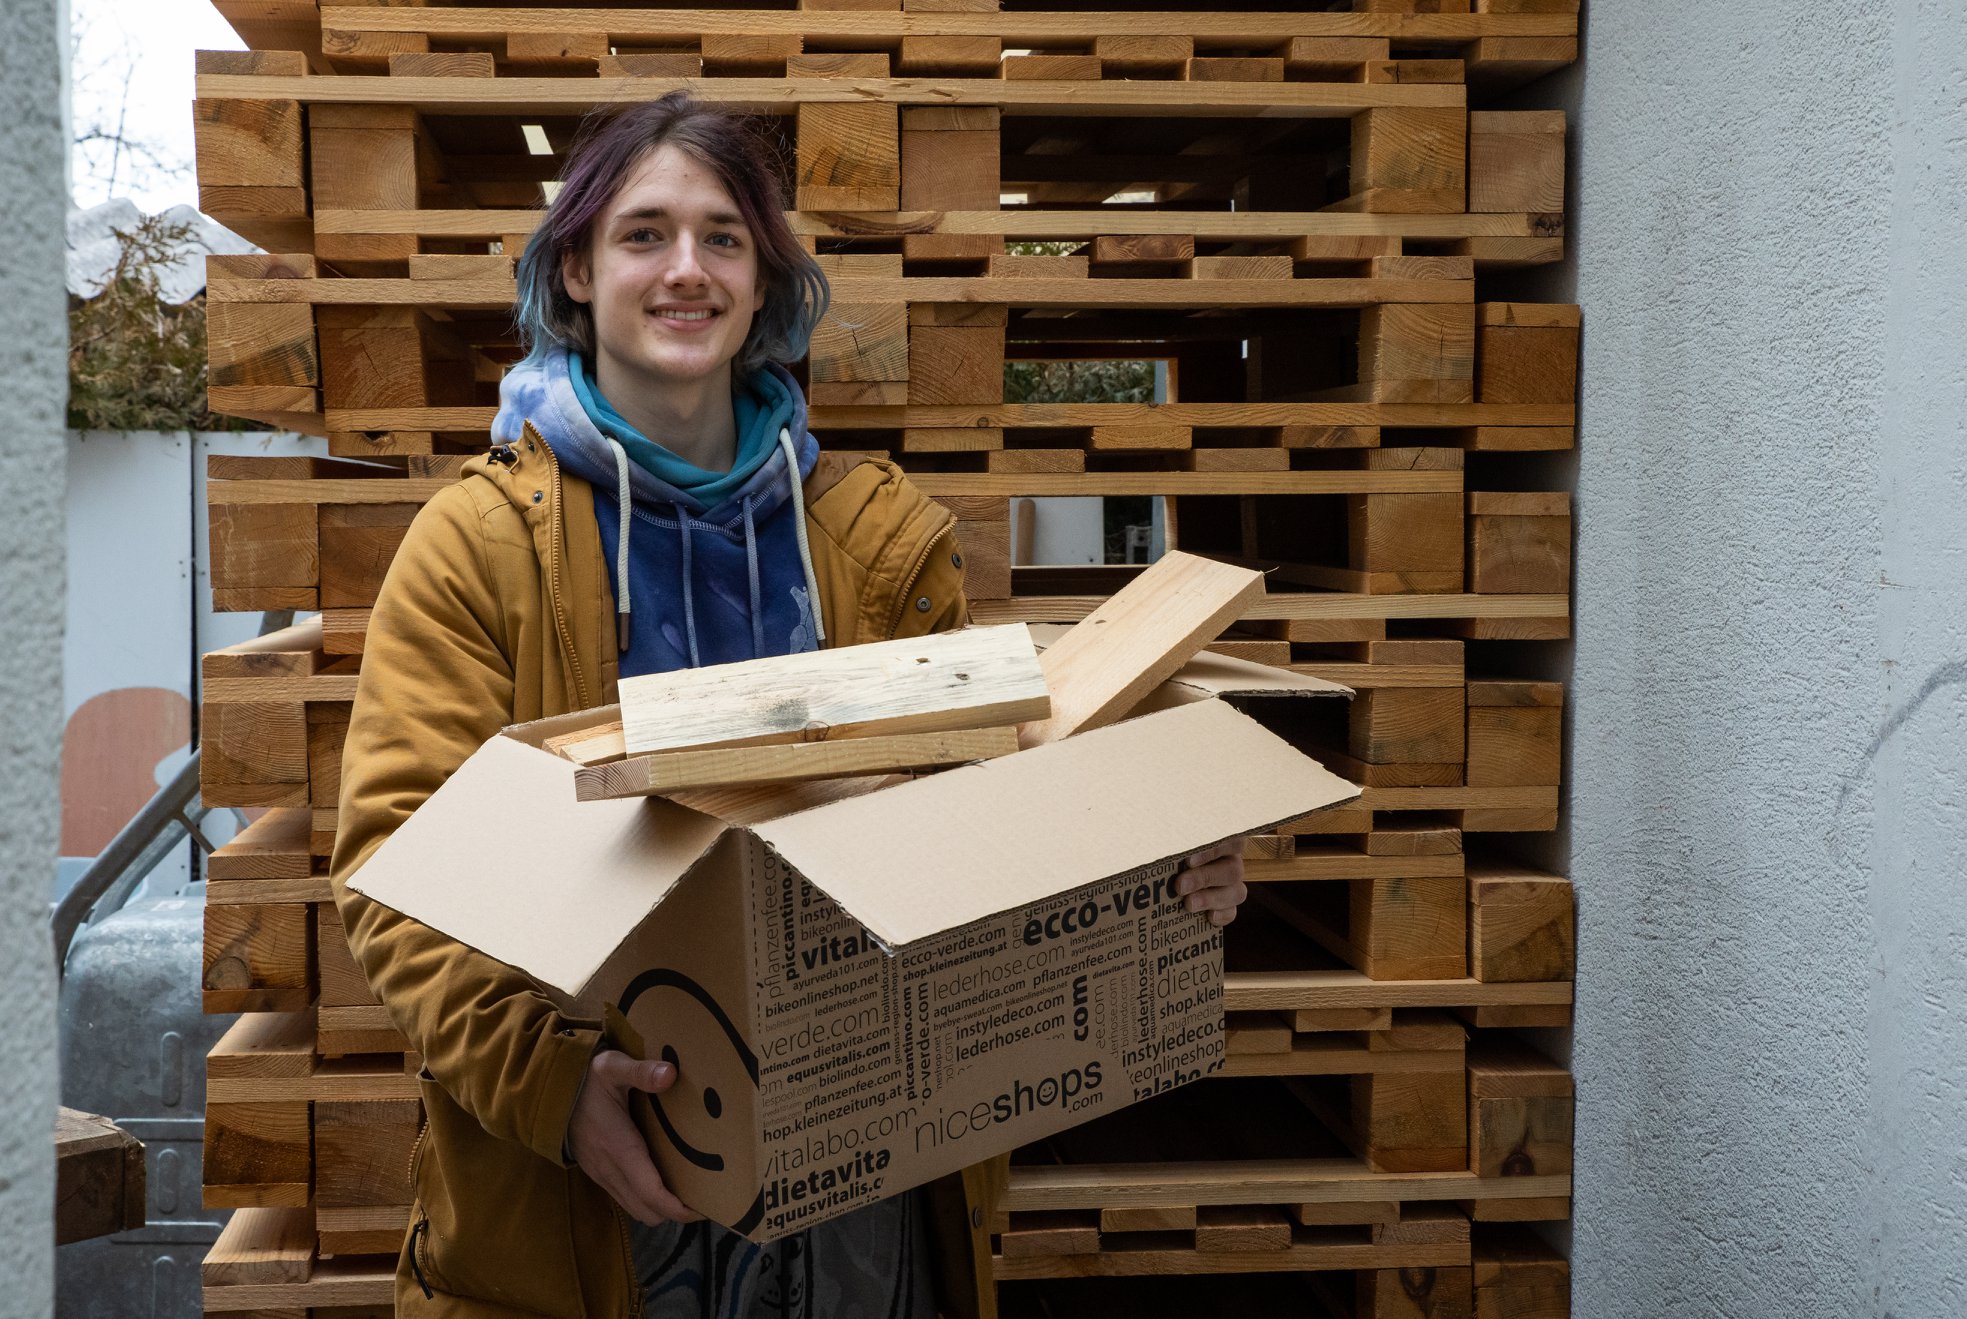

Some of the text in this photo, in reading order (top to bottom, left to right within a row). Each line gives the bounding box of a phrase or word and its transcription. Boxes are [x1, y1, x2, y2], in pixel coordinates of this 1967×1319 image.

[902, 927, 1006, 968] ecco-verde.com
[1070, 920, 1134, 946] instyledeco.com
[1071, 930, 1134, 957] ayurveda101.com
[1157, 929, 1223, 975] piccanti
[793, 956, 879, 991] ayurveda101.com
[903, 941, 1008, 982] shop.kleinezeitung.at
[933, 945, 1065, 1001] lederhose.com
[934, 945, 1132, 1018] aquamedica.com pflanzenfee.com
[1092, 960, 1136, 979] dietavita.com
[1137, 916, 1149, 1043] lederhose.com
[1157, 958, 1223, 998] dietav
[765, 972, 880, 1018] bikeonlineshop.net
[814, 990, 878, 1017] lederhose.com
[933, 980, 1068, 1032] byebye-sweat.com bikeonlineshop.net
[956, 994, 1065, 1041] instyledeco.com
[1072, 975, 1088, 1041] com
[1148, 960, 1156, 1039] aquamedica.com
[761, 1007, 879, 1060] verde.com
[956, 1014, 1065, 1062] lederhose.com
[1161, 1003, 1223, 1035] aquamedica
[760, 1026, 890, 1076] ntino.com dietavita.com
[786, 1041, 891, 1084] equusvitalis.com
[902, 985, 917, 1101] piccantino.com
[916, 981, 932, 1106] o-verde.com
[934, 1035, 943, 1092] neshop.net
[804, 1069, 902, 1113] pflanzenfee.com
[819, 1056, 891, 1087] biolindo.com
[763, 1085, 902, 1143] hop.kleinezeitung.at
[915, 1060, 1103, 1153] niceshops
[1068, 1091, 1104, 1115] .com
[766, 1148, 891, 1211] dietavita
